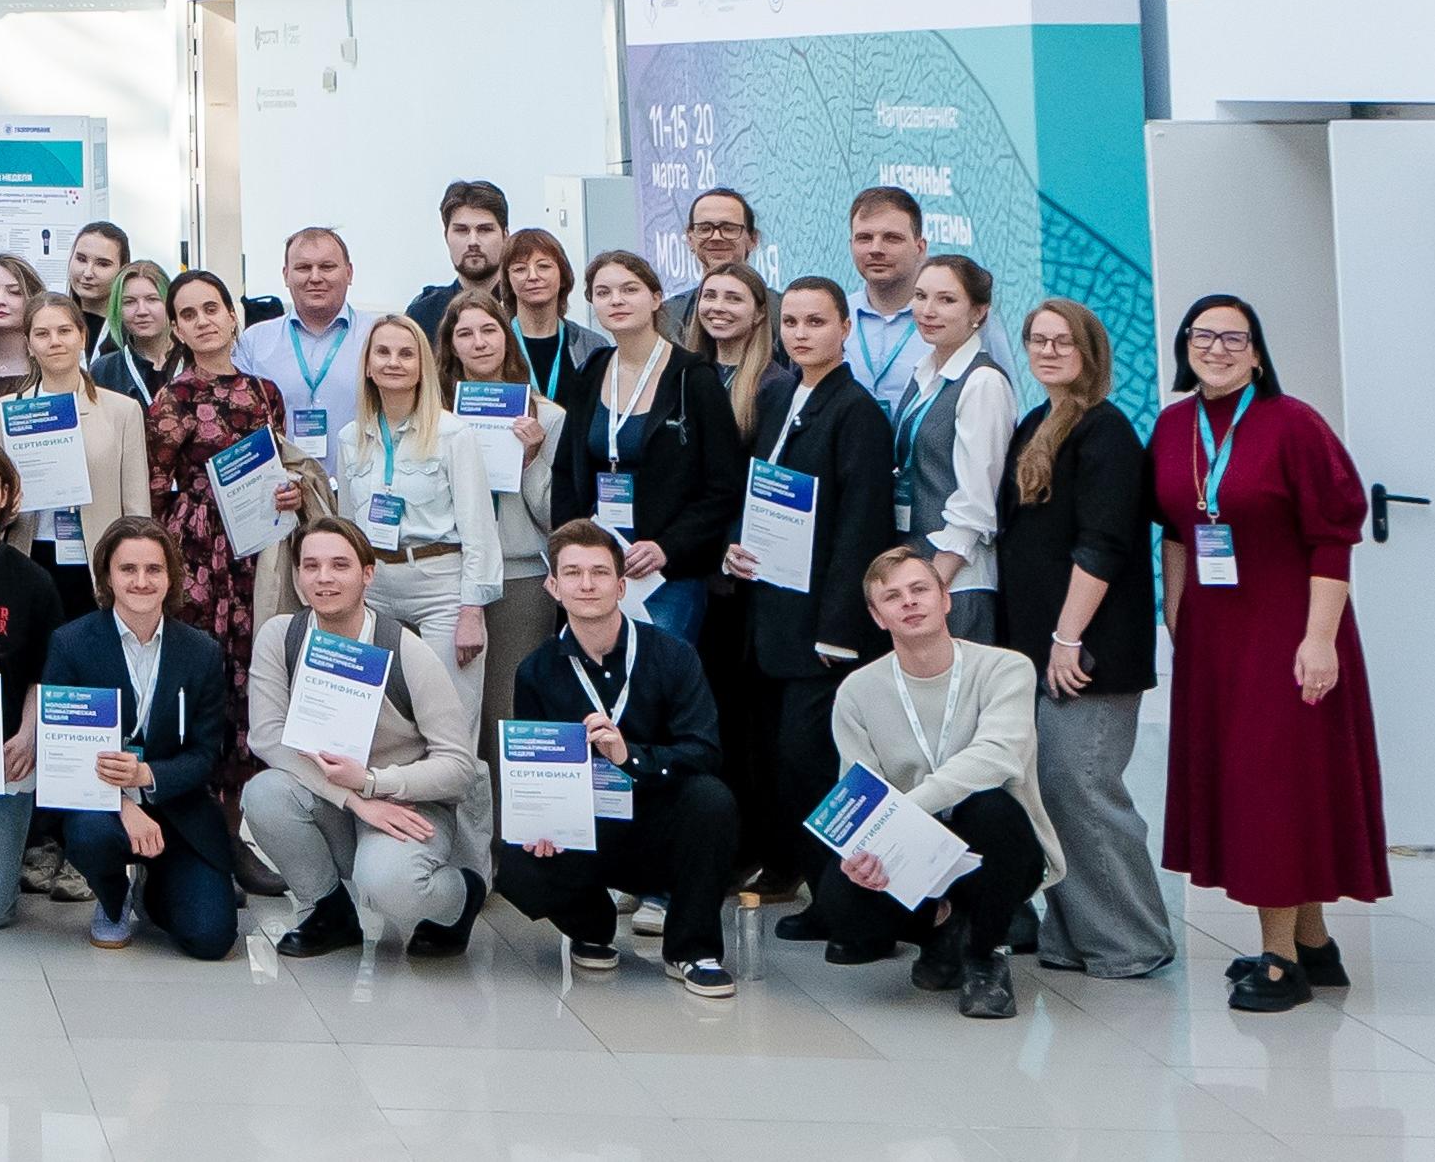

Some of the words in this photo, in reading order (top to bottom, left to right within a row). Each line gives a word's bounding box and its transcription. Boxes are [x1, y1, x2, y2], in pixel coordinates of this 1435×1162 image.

[694, 104, 714, 145] 20
[652, 162, 689, 197] марта
[697, 149, 716, 190] 26
[13, 437, 73, 451] СЕРТИФИКАТ
[305, 676, 371, 700] СЕРТИФИКАТ
[45, 733, 110, 742] СЕРТИФИКАТ
[510, 770, 580, 779] СЕРТИФИКАТ
